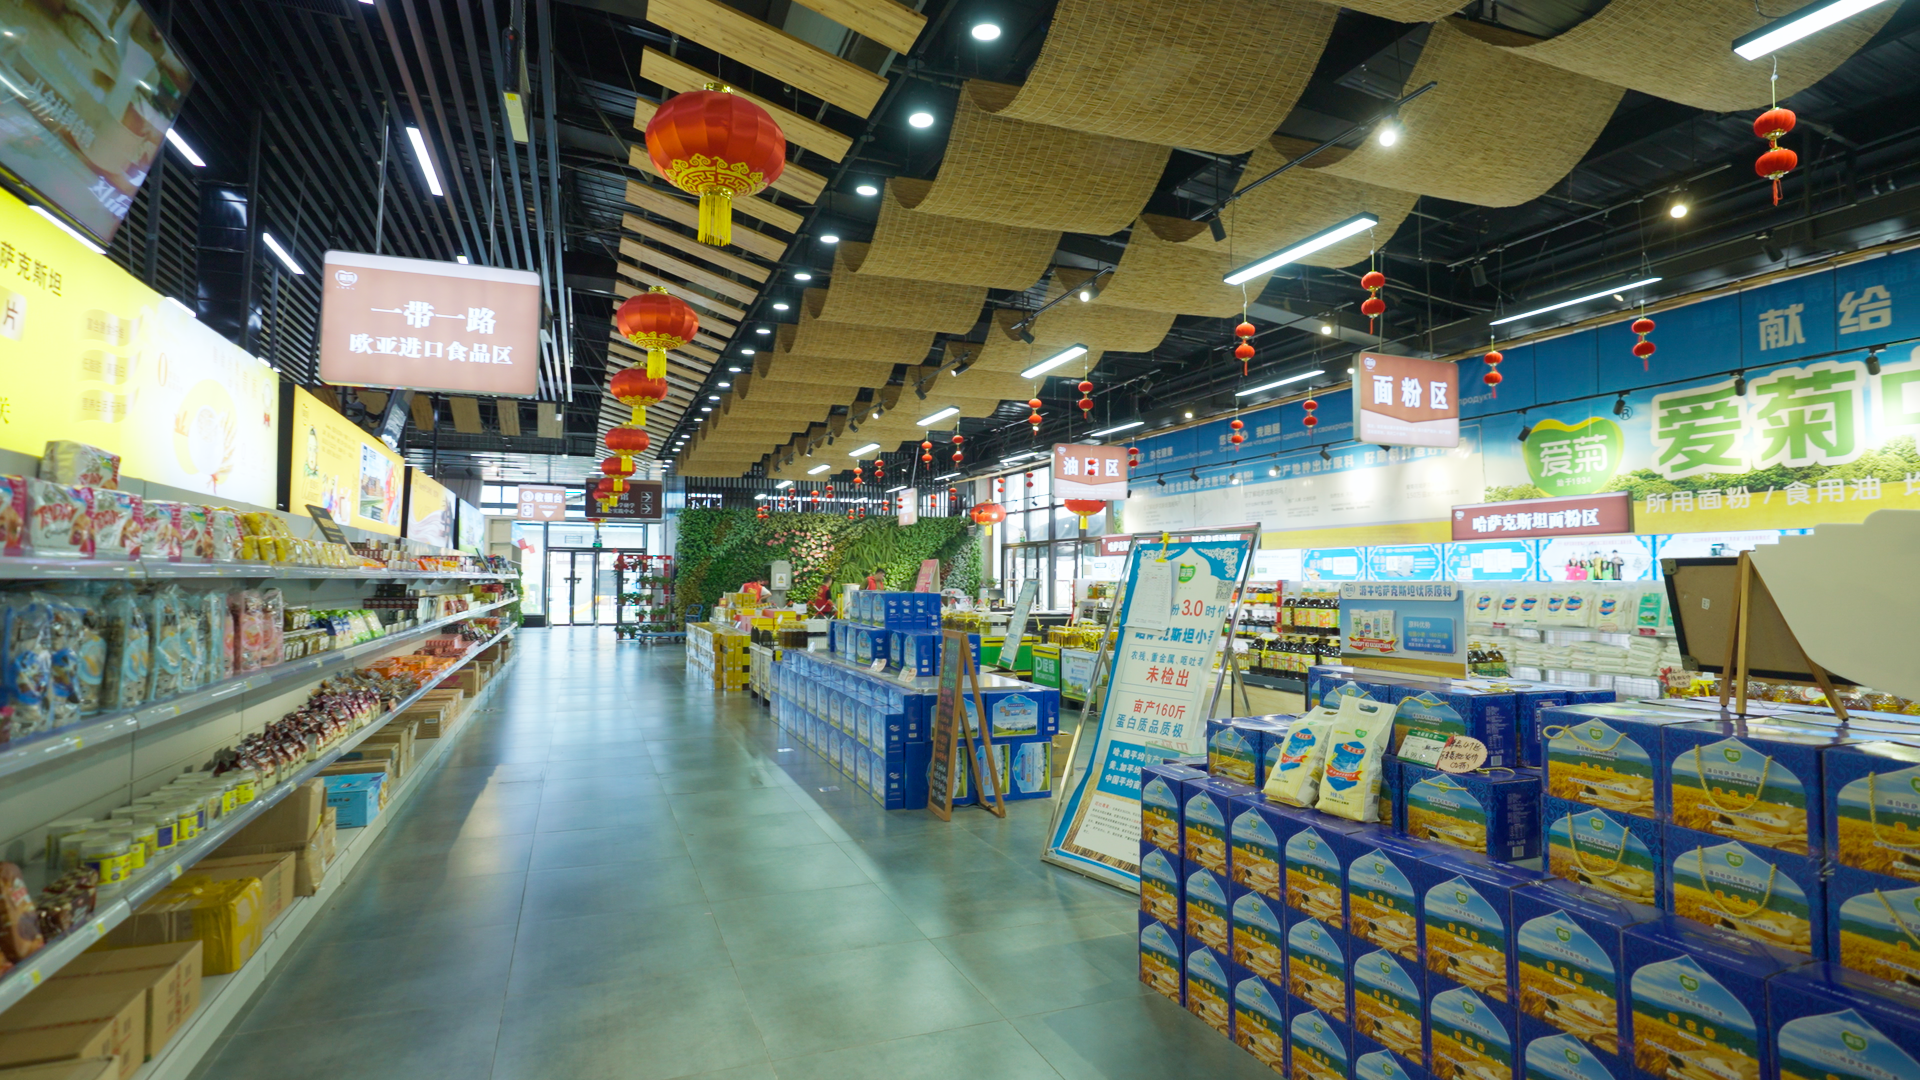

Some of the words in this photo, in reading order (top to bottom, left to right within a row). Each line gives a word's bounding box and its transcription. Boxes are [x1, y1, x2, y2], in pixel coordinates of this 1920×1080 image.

[371, 300, 497, 335] 一带一路
[349, 333, 514, 365] 欧亚进口食品区
[1372, 373, 1449, 411] 面粉区
[1539, 433, 1608, 478] 爱菊
[1472, 507, 1600, 533] 哈萨克斯坦面粉区
[1359, 584, 1452, 598] 源于哈萨克斯坦优质原料
[1146, 665, 1190, 688] 未检出
[1133, 698, 1186, 720] 亩产160斤
[1116, 713, 1184, 738] 蛋白质品质极
